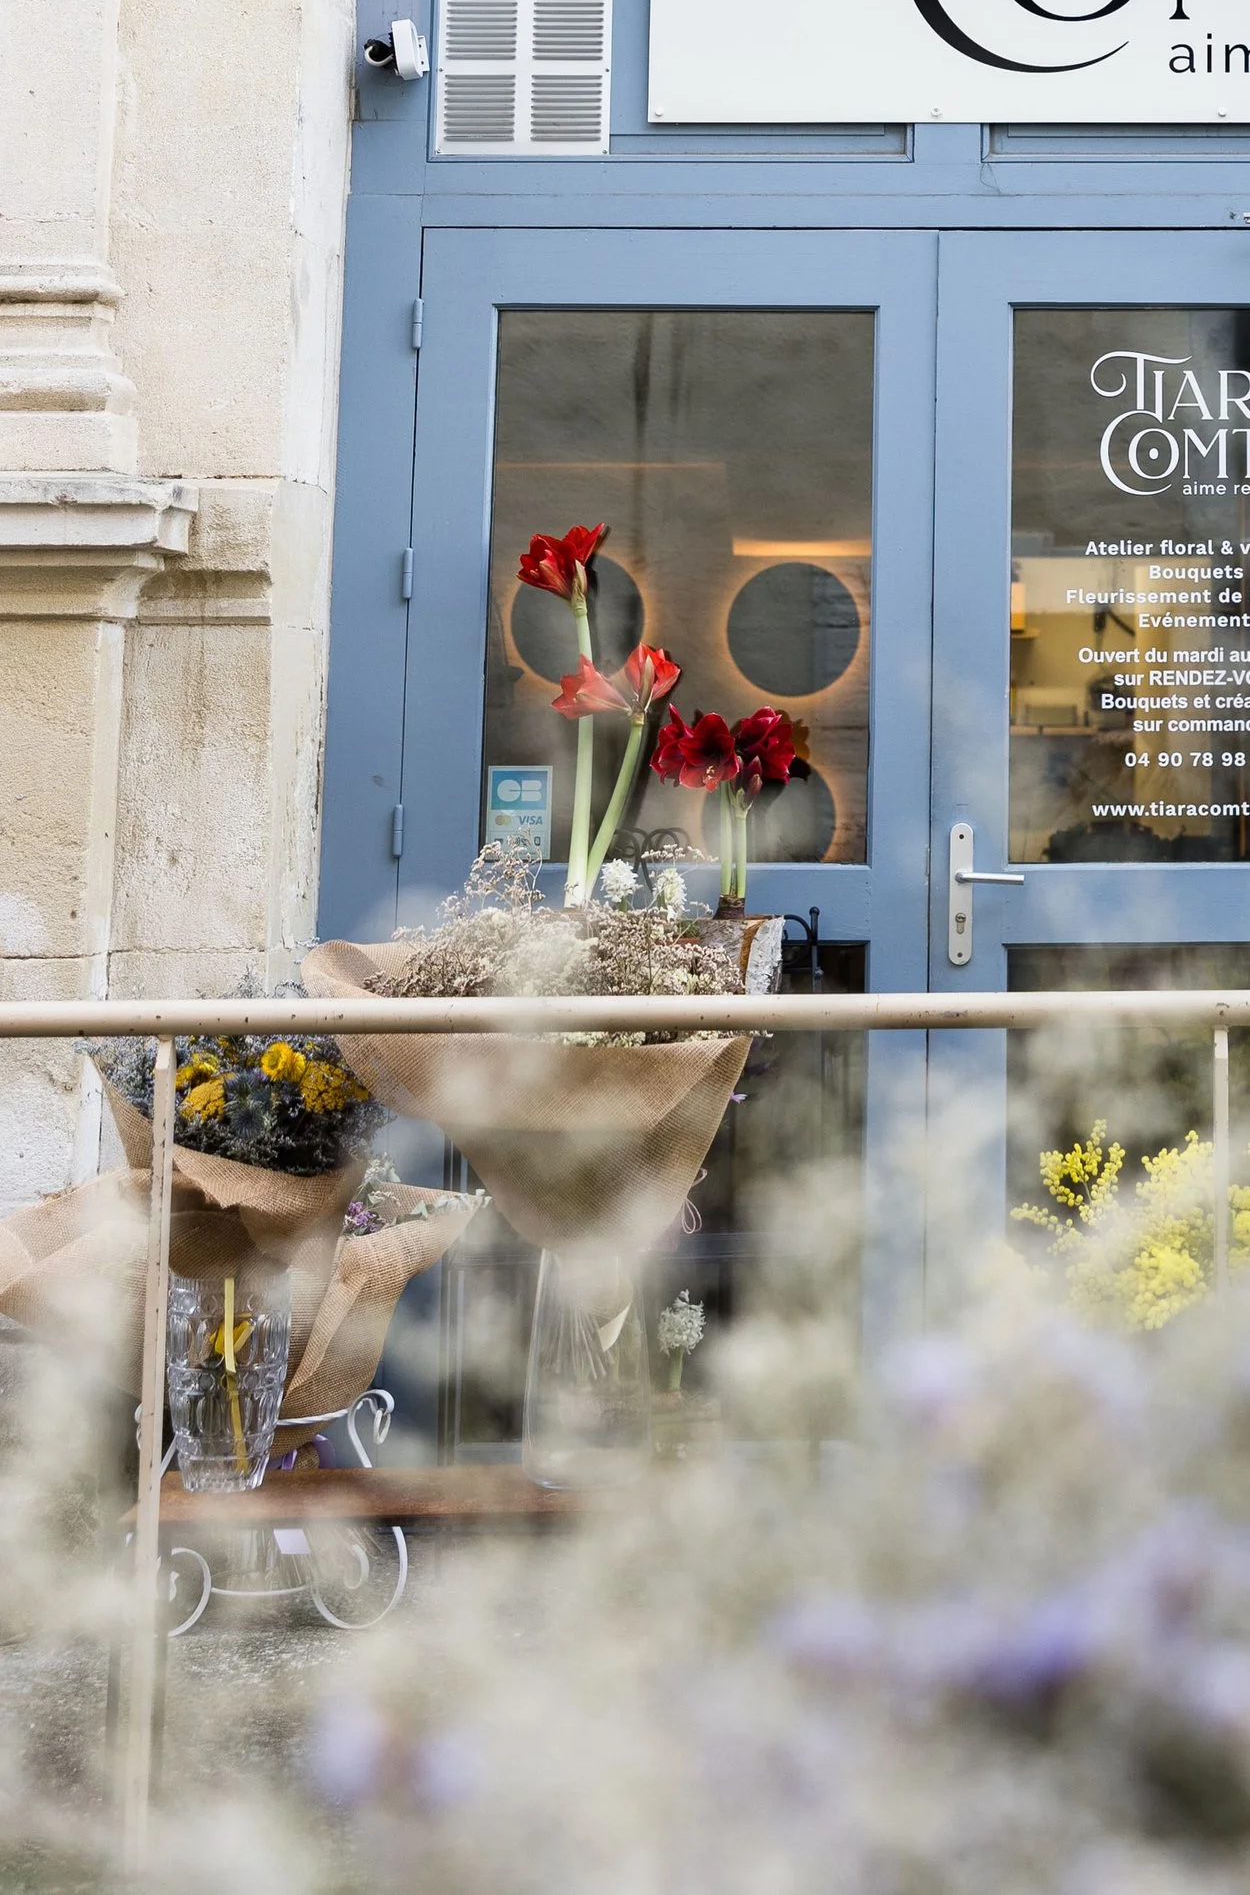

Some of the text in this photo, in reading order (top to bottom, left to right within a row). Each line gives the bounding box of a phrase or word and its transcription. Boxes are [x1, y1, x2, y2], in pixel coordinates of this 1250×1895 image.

[1182, 482, 1227, 496] aime
[1085, 538, 1154, 557] Atelier
[1160, 538, 1215, 557] floral
[1220, 539, 1234, 557] &
[1148, 564, 1244, 583] Bouquets
[1066, 588, 1212, 604] Fleurissement
[1218, 587, 1243, 604] de
[1078, 647, 1140, 664] Ouvert
[1144, 646, 1168, 664] du
[1172, 646, 1224, 664] mardi
[1113, 673, 1145, 687] sur
[1101, 692, 1188, 713] Bouquets
[1193, 693, 1211, 711] et
[1133, 719, 1164, 733] sur
[1124, 751, 1151, 768] 04
[1157, 751, 1183, 768] 90
[1189, 751, 1214, 768] 78
[1221, 751, 1247, 768] 98
[519, 815, 543, 826] VISA
